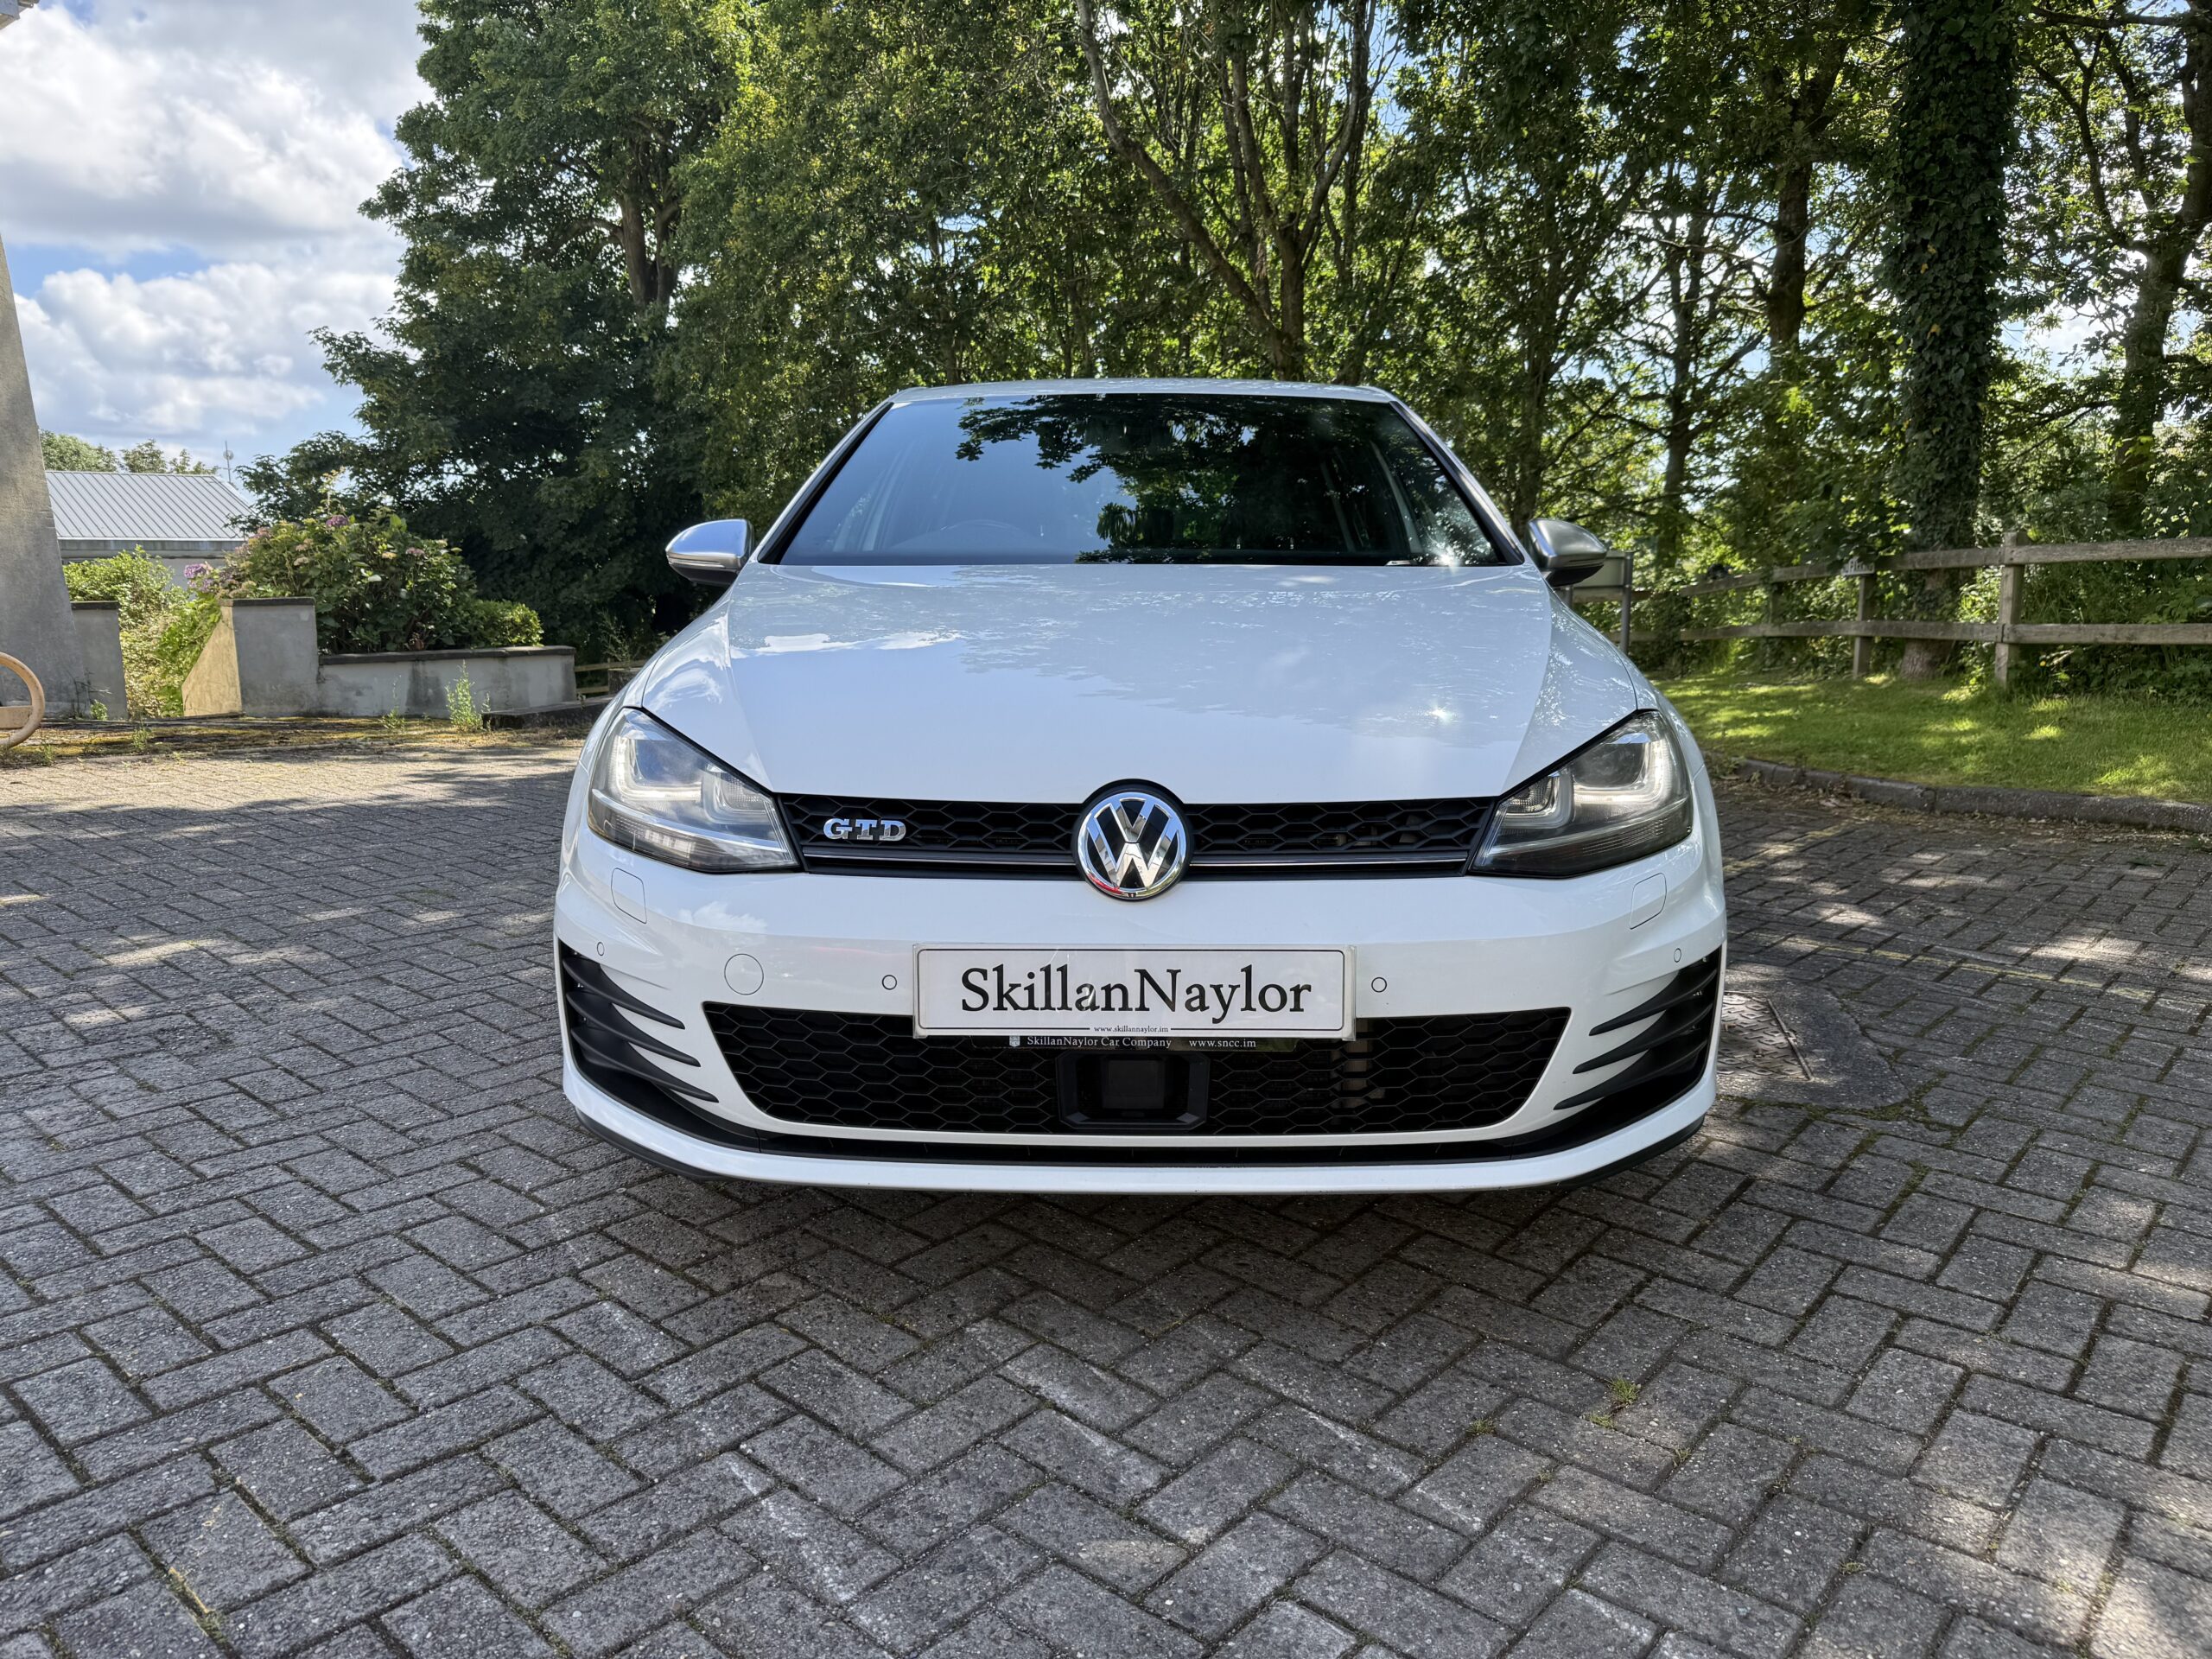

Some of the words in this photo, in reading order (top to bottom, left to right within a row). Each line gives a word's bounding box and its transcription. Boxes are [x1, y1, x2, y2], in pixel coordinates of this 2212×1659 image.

[823, 818, 906, 841] GTD
[1084, 795, 1182, 895] VW
[961, 964, 1312, 1024] SkillanNaylor
[1027, 1036, 1098, 1046] SkillanNaylor
[1101, 1037, 1120, 1046] Car
[1122, 1037, 1172, 1048] Company
[1189, 1039, 1256, 1048] www.sncc.im
